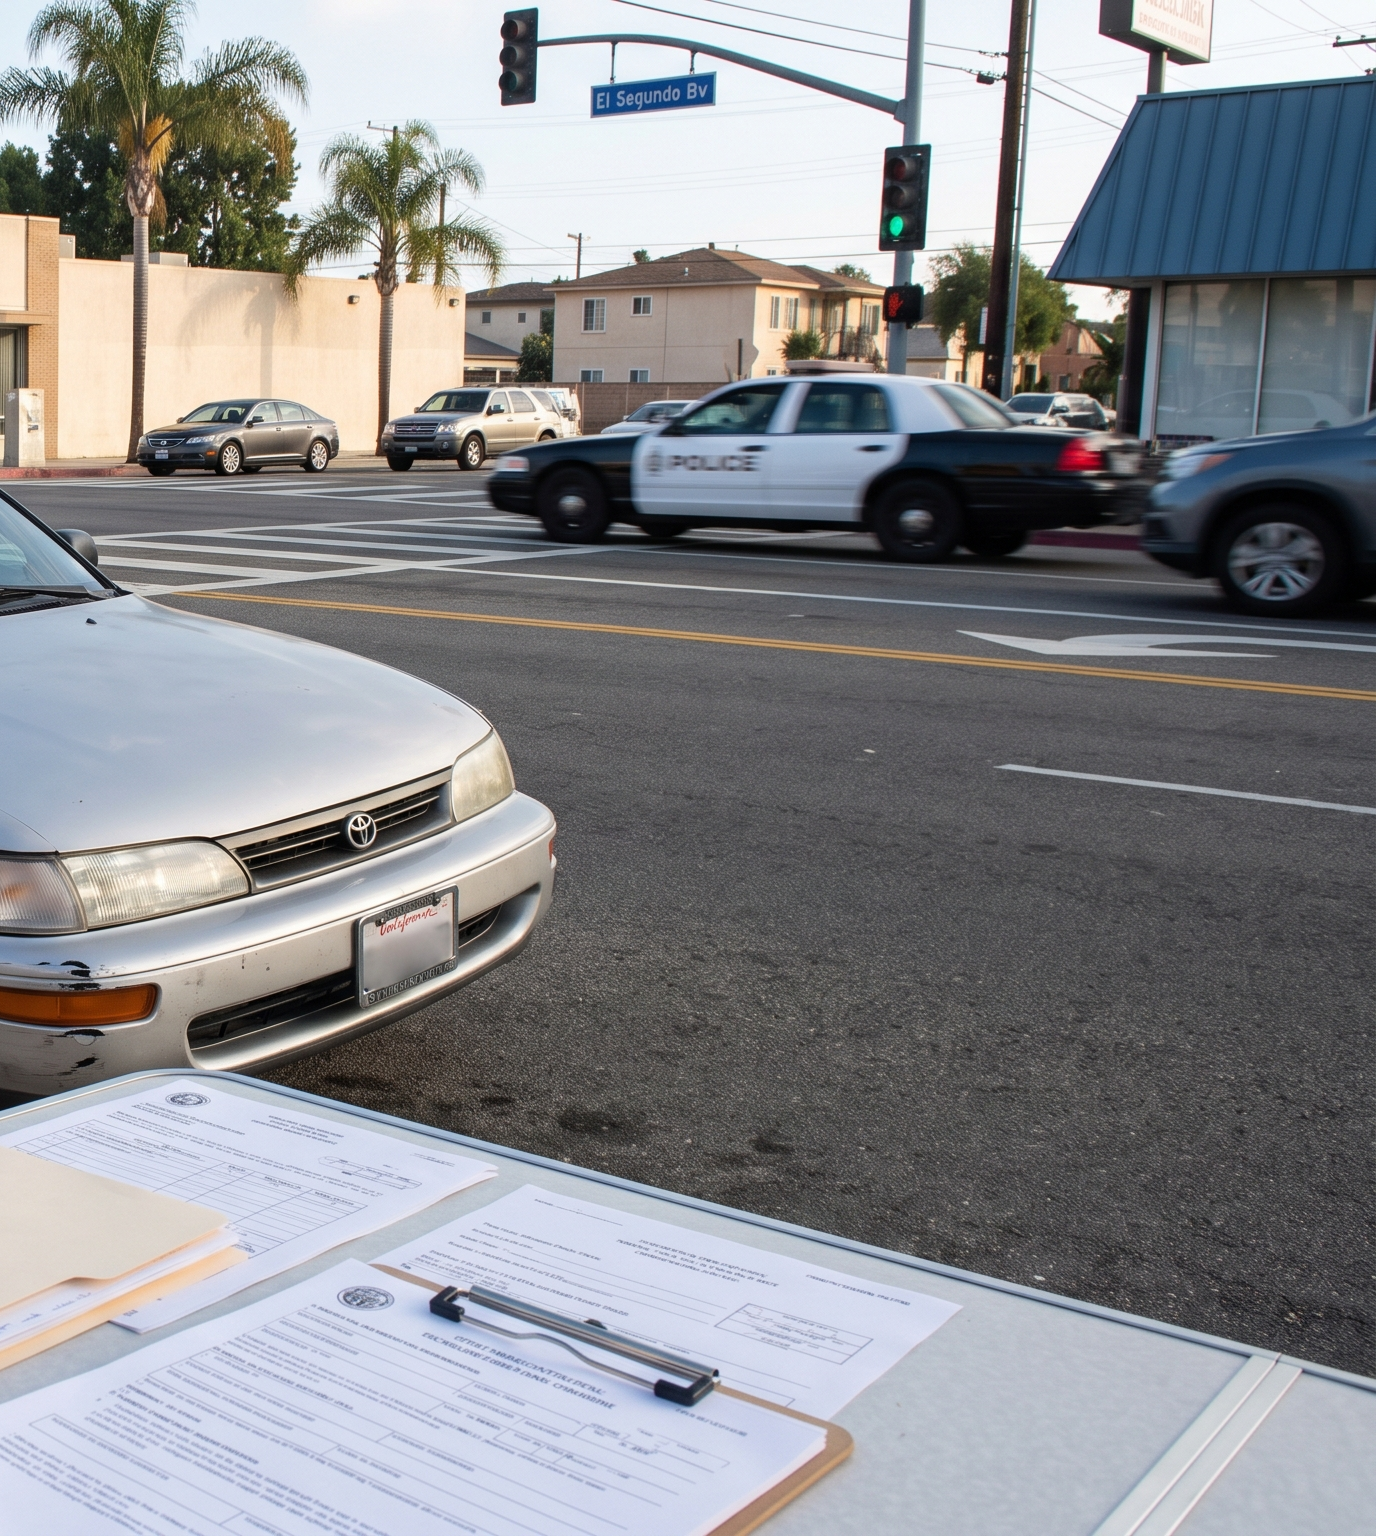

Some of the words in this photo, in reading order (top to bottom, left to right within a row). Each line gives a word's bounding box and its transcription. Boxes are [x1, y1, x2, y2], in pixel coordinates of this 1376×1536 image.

[596, 91, 610, 109] El
[616, 85, 680, 110] Segundo
[687, 82, 708, 99] Bv
[666, 455, 760, 471] POLICE
